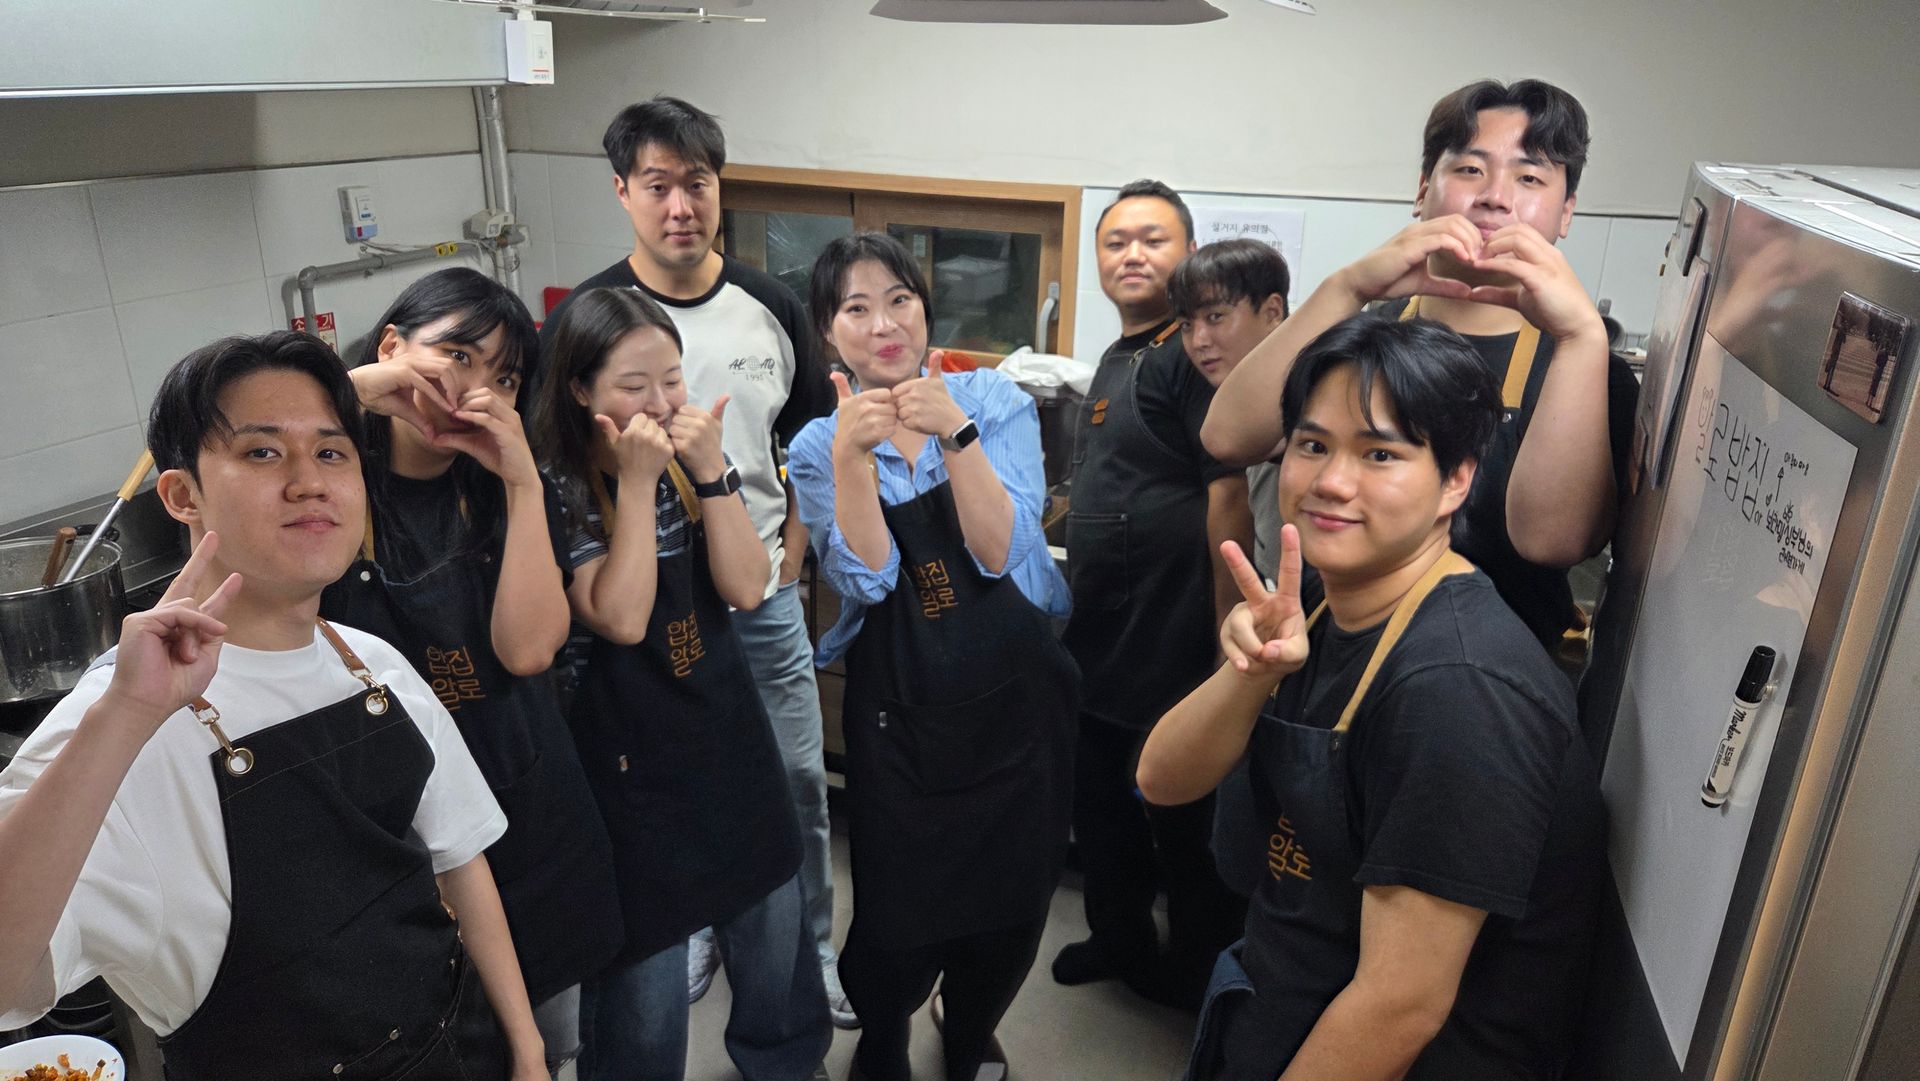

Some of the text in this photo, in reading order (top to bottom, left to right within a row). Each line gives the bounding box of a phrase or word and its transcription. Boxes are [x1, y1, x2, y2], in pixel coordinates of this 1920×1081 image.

[1211, 222, 1238, 233] 설거지
[294, 313, 333, 331] 소기
[1727, 708, 1747, 741] Marker
